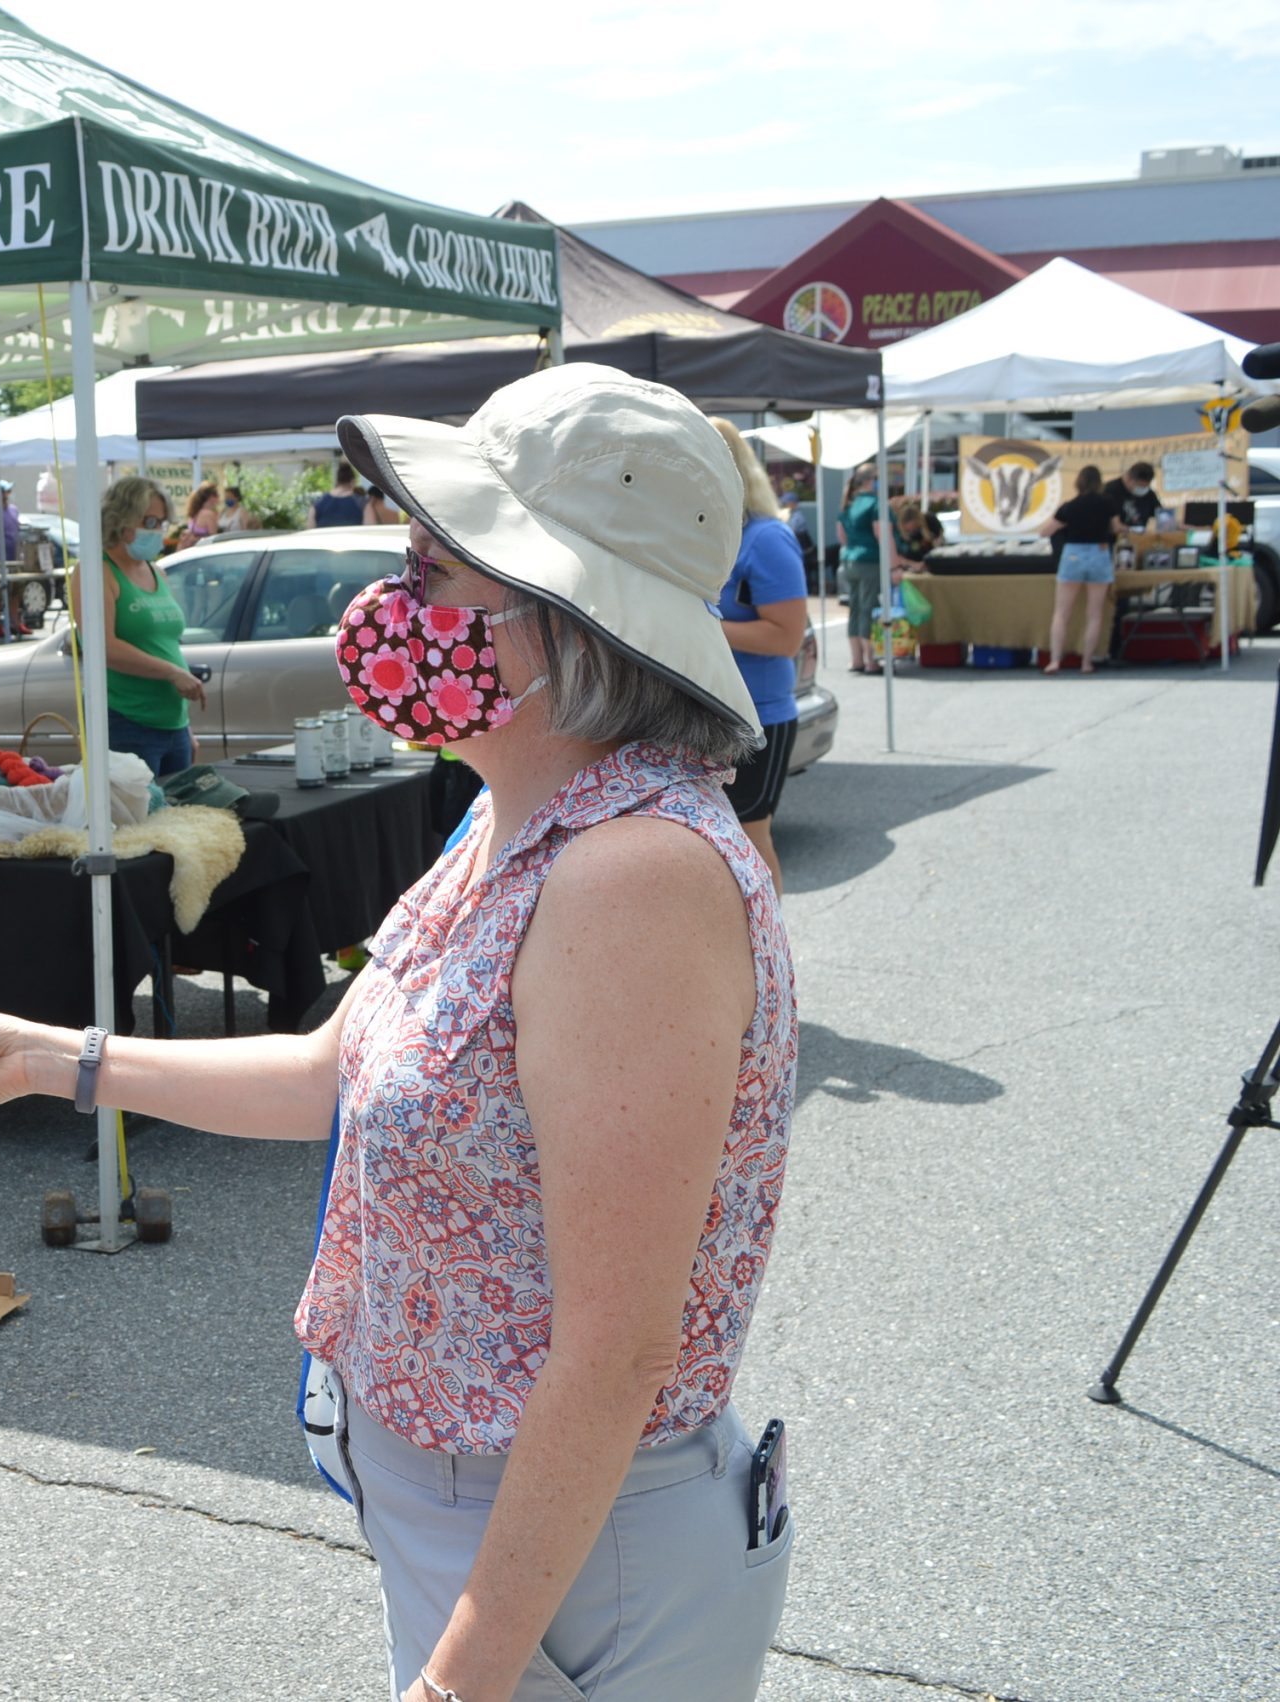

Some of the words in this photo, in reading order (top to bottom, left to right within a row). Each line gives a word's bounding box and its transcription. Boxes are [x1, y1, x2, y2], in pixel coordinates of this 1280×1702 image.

[97, 160, 244, 264] DRINK
[241, 189, 340, 277] BEER
[407, 223, 498, 298] GROWN
[497, 242, 558, 307] HERE
[862, 292, 915, 325] PEACE
[917, 291, 931, 323] A
